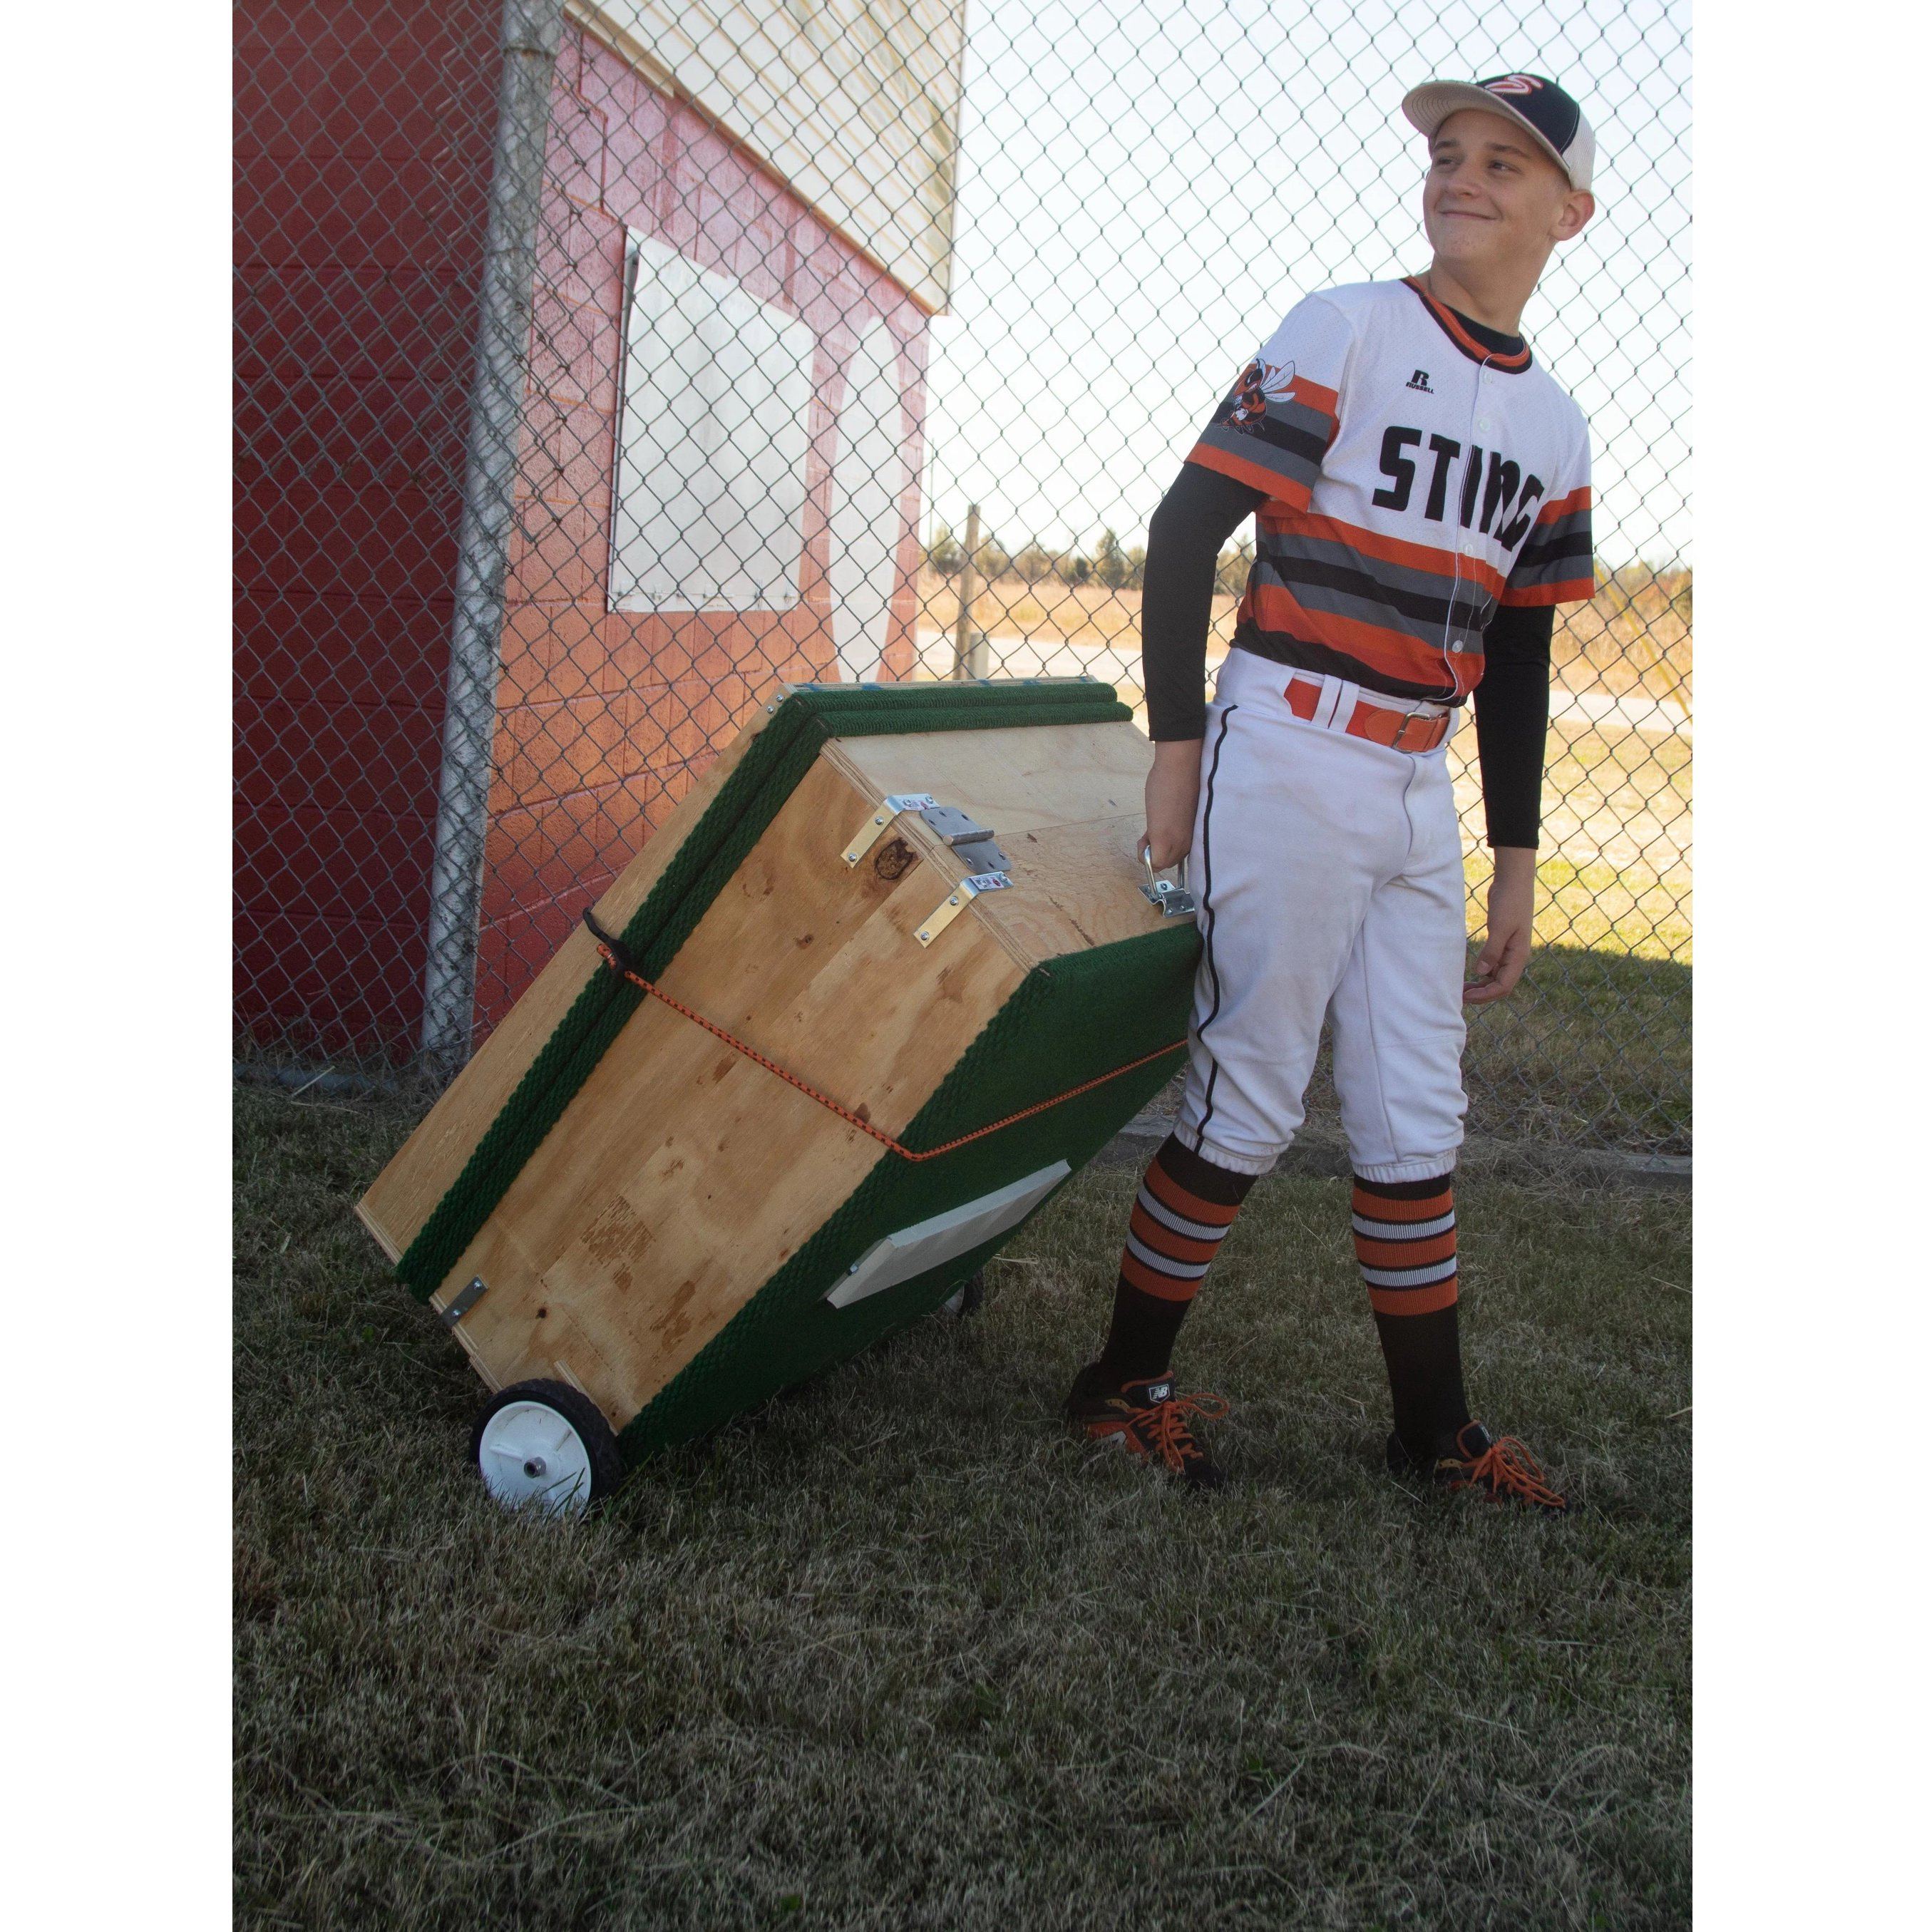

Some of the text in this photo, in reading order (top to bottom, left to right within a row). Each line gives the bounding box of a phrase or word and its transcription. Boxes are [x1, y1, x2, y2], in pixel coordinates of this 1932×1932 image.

[1411, 369, 1429, 386] R
[1405, 381, 1434, 394] RUSSELL
[1372, 426, 1545, 553] STING
